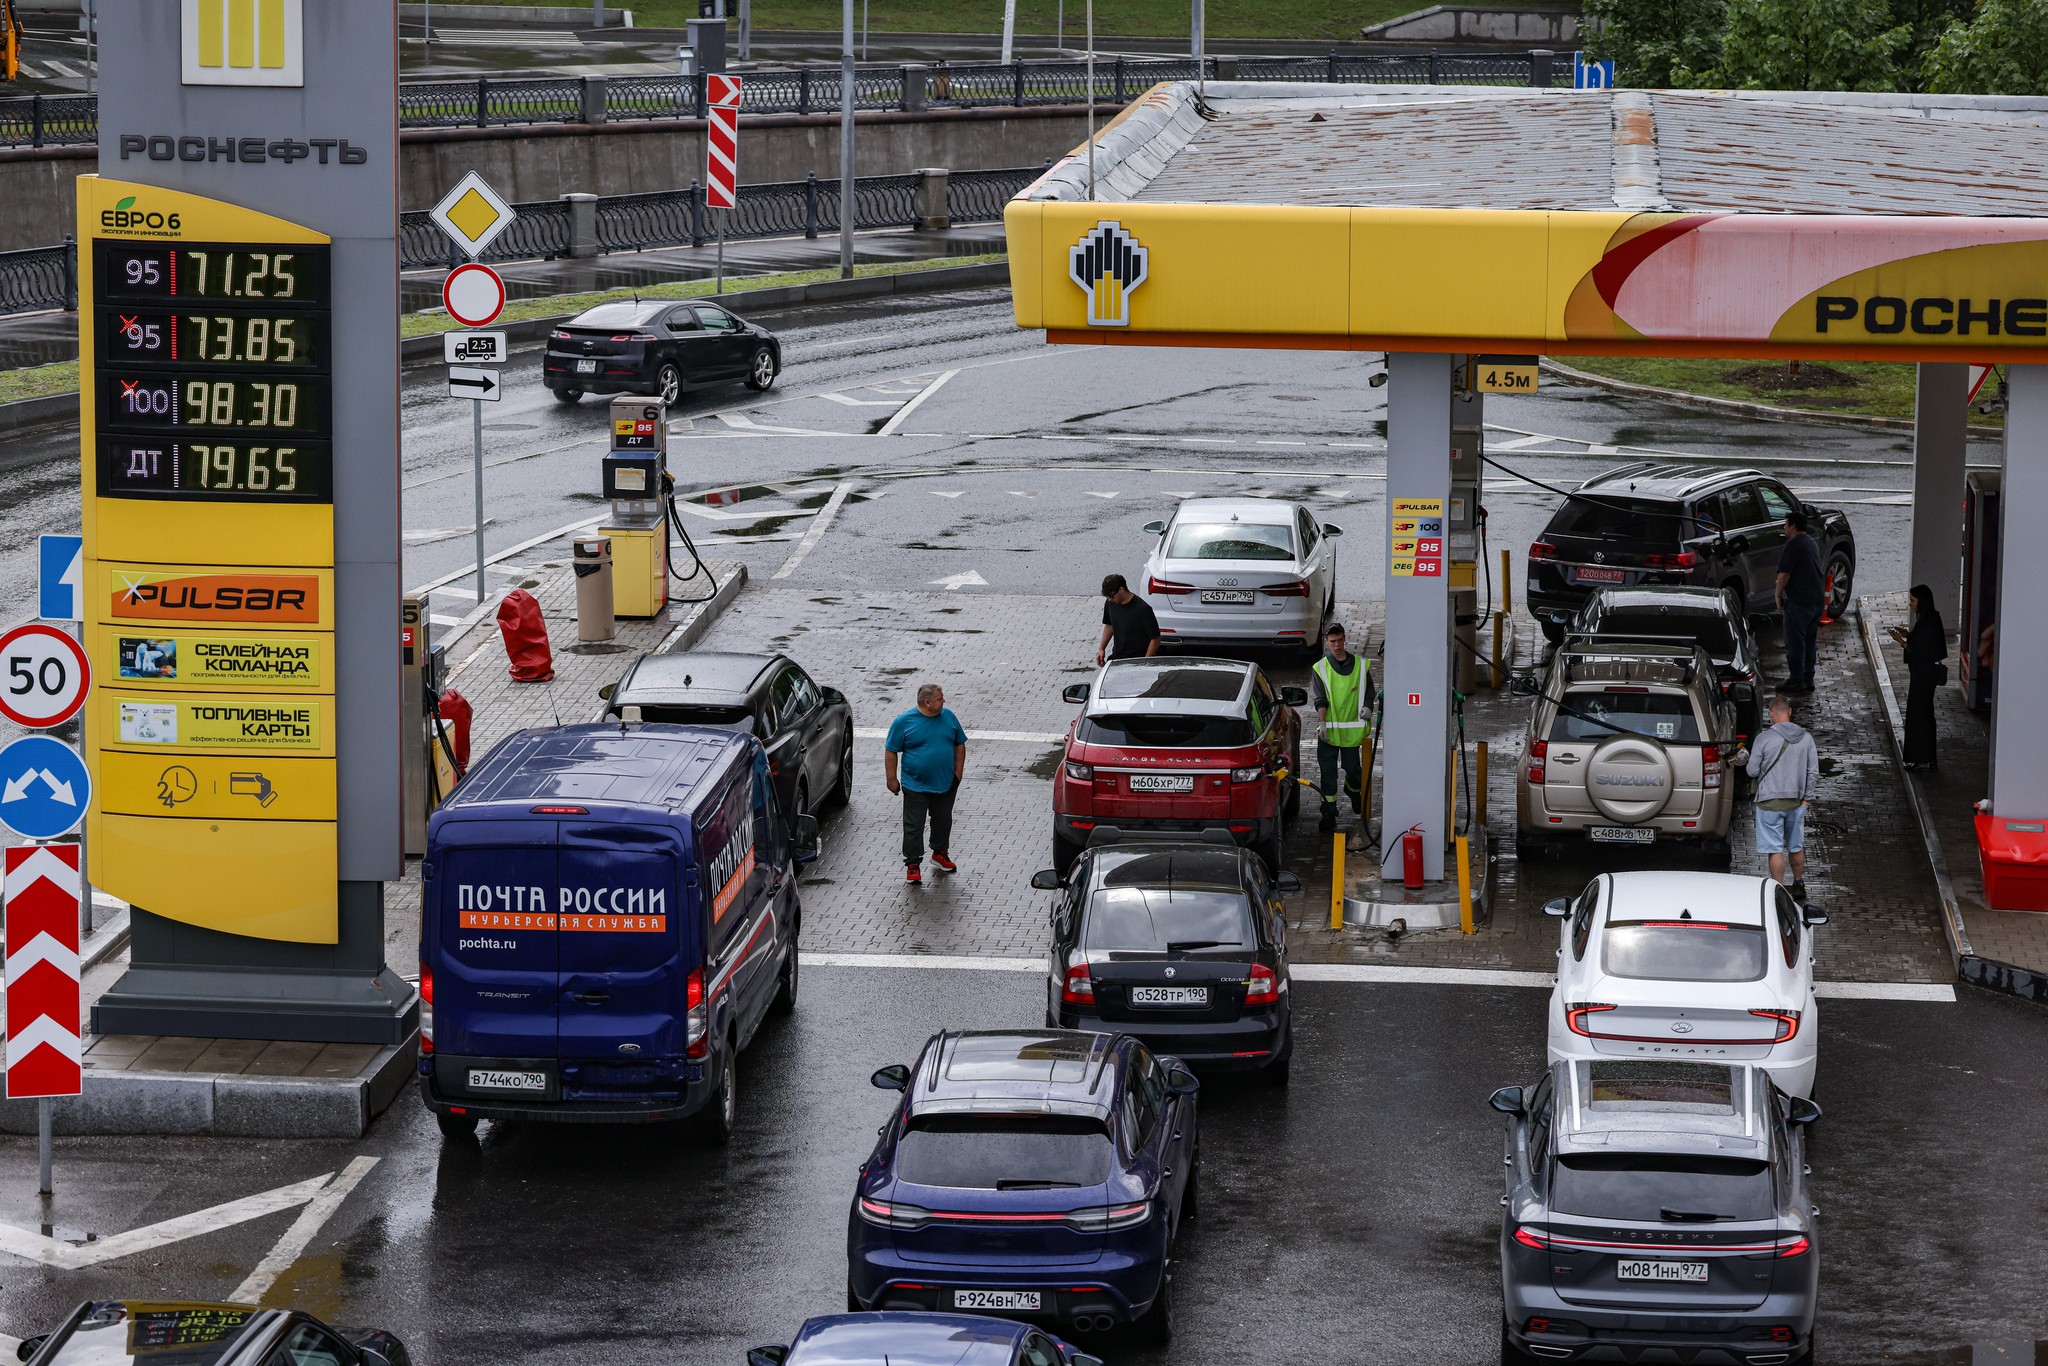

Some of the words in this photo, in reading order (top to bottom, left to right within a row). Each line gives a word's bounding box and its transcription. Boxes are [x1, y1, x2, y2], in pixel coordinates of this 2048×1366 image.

[120, 134, 367, 165] РОСНЕФТЬ
[101, 210, 164, 229] ЕВРО
[168, 213, 181, 230] 6
[126, 259, 160, 285] 95
[187, 252, 295, 298] 71.25
[1816, 296, 2048, 336] РОСНЕ
[127, 323, 161, 350] 95
[188, 316, 296, 362] 73.85
[472, 339, 493, 351] 2,5т
[123, 388, 169, 414] 100
[187, 381, 297, 427] 98.30
[643, 405, 659, 421] 6
[637, 424, 653, 432] 95
[627, 436, 643, 445] ДТ
[126, 449, 163, 478] ДТ
[190, 445, 297, 491] 79.65
[1419, 523, 1440, 532] 100
[1420, 543, 1439, 552] 95
[1418, 563, 1436, 572] 95
[130, 584, 306, 611] PULSAR
[1204, 591, 1237, 601] С457НР
[403, 605, 419, 624] 5
[195, 642, 309, 659] СЕМЕЙНАЯ
[205, 658, 309, 674] КОМАНДА
[10, 656, 66, 696] 50
[190, 672, 227, 680] программа
[191, 706, 309, 722] ТОПЛИВНЫЕ
[242, 723, 310, 737] КАРТЫ
[1133, 777, 1173, 788] М606ХР
[1175, 777, 1190, 785] 777
[1596, 773, 1665, 787] SUZUKI
[1636, 829, 1651, 838] 197
[710, 842, 734, 899] ПОЧТА
[458, 884, 546, 912] ПОЧТА
[560, 886, 666, 914] РОССИИ
[469, 914, 580, 929] КУРЬЕРСКАЯ
[586, 917, 659, 929] СЛУЖБА
[459, 936, 516, 950] pochta.ru
[476, 991, 531, 999] TRANSIT
[1136, 989, 1184, 1001] О528ТР
[1186, 988, 1204, 998] 190
[1637, 1046, 1726, 1054] SONATA
[473, 1073, 521, 1087] В744КО
[523, 1073, 542, 1084] 790
[1612, 1231, 1715, 1240] МОСКВИЧ
[1621, 1262, 1680, 1279] М081НН
[1682, 1263, 1704, 1275] 977
[958, 1292, 1014, 1307] Р924ВН
[1016, 1293, 1037, 1304] 716
